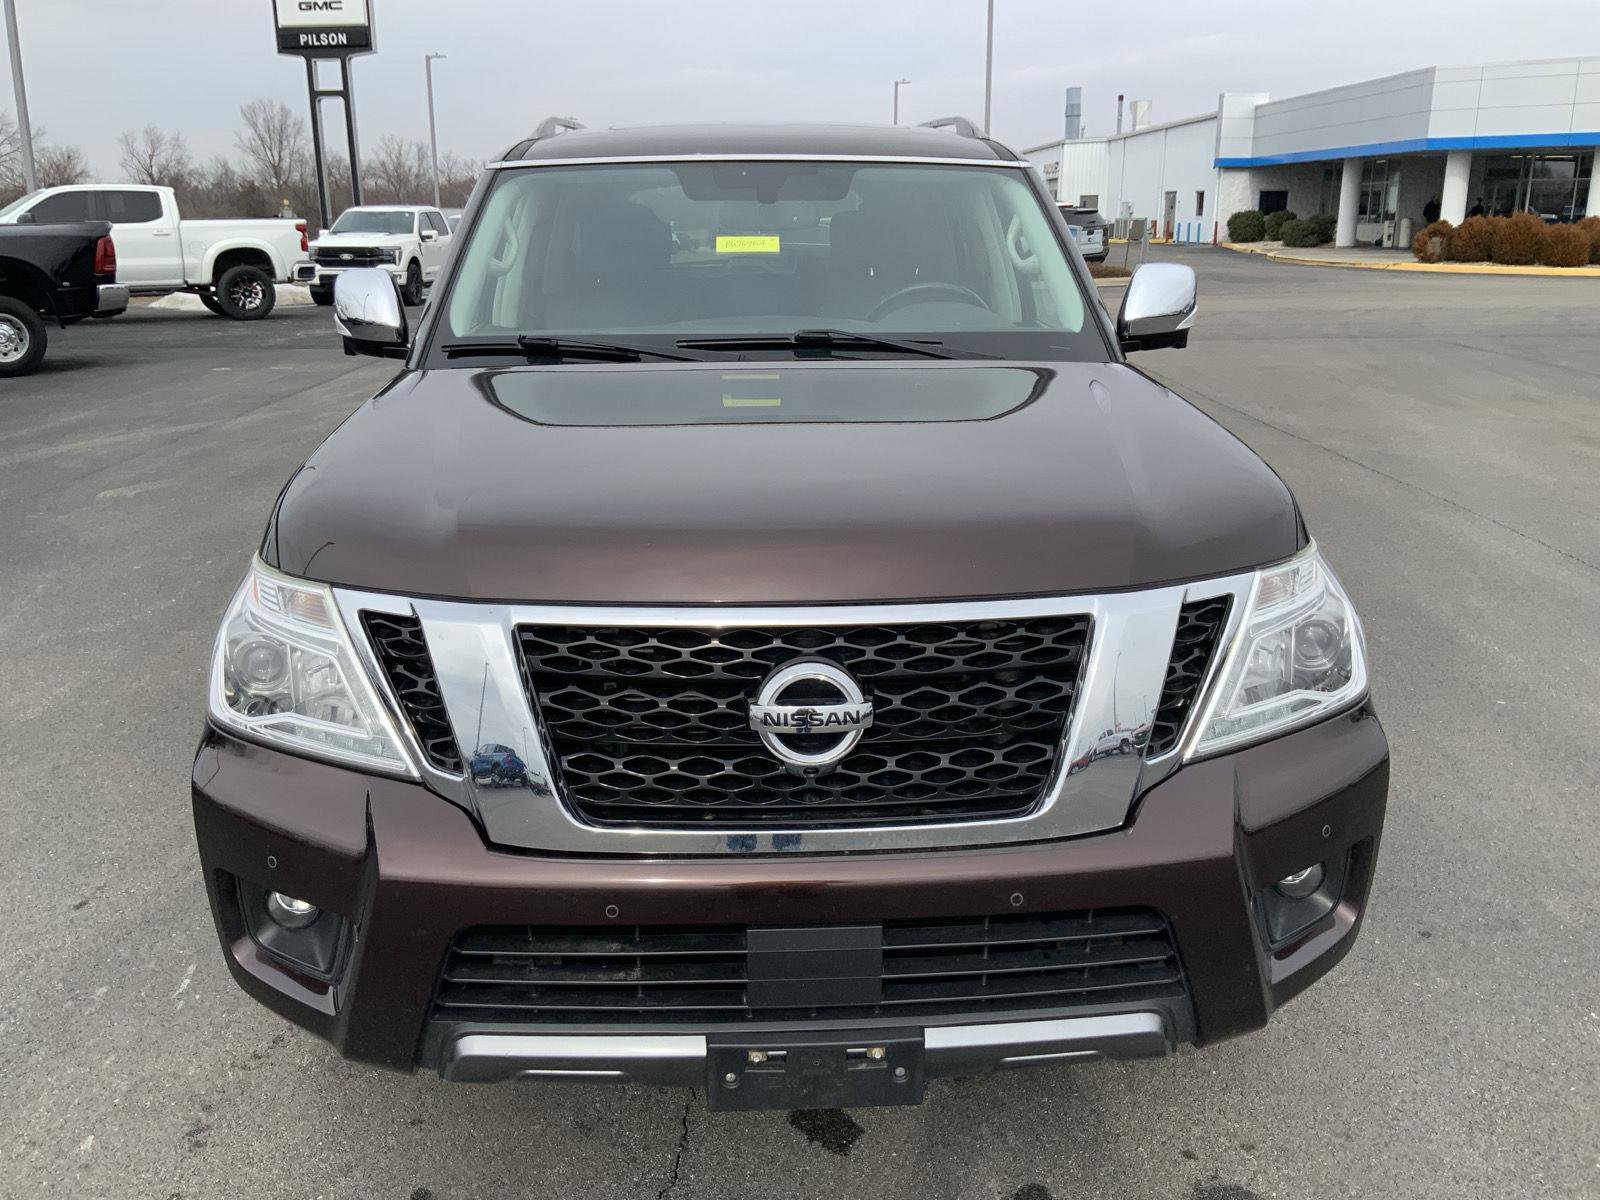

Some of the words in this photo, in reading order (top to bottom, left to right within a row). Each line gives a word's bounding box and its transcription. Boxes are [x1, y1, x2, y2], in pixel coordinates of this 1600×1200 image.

[298, 1, 343, 11] GMC
[299, 33, 348, 46] PILSON
[763, 710, 860, 727] NISSAN
